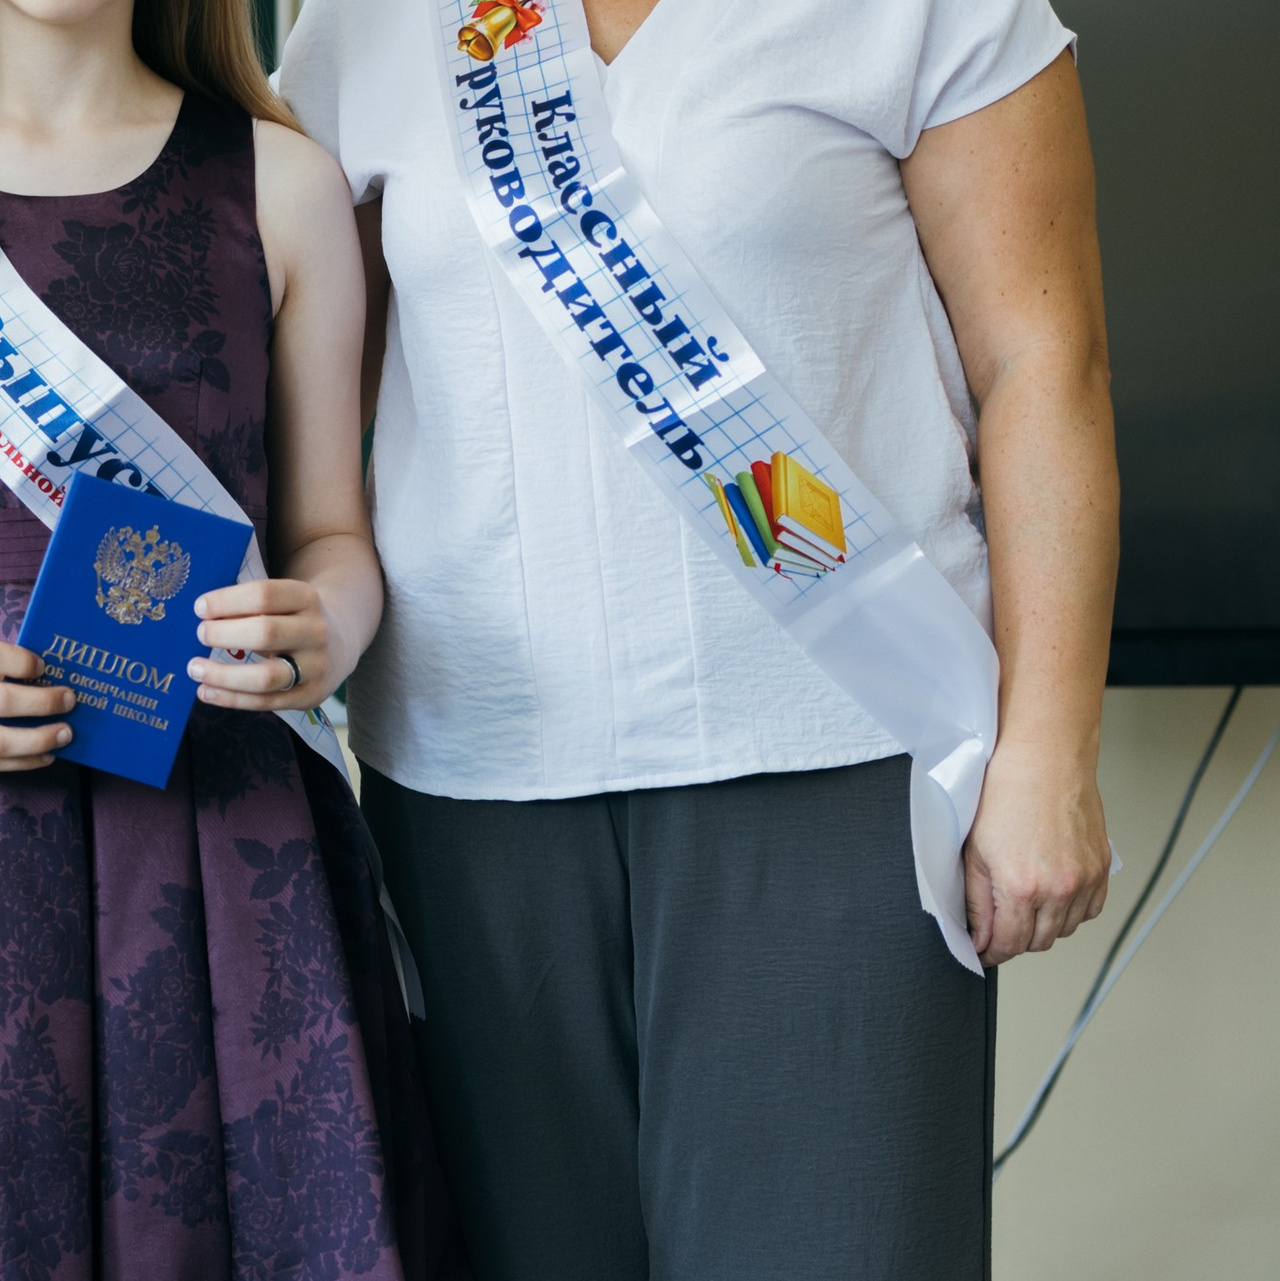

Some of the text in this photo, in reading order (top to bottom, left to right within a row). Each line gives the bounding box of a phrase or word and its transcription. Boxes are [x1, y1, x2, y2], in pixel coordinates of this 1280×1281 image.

[455, 61, 706, 472] руководитель
[42, 634, 176, 695] ДИПЛОМ
[44, 664, 66, 680] ОБ
[69, 672, 159, 711] ОКОНЧАНИИ
[112, 703, 170, 732] ШКОЛЫ
